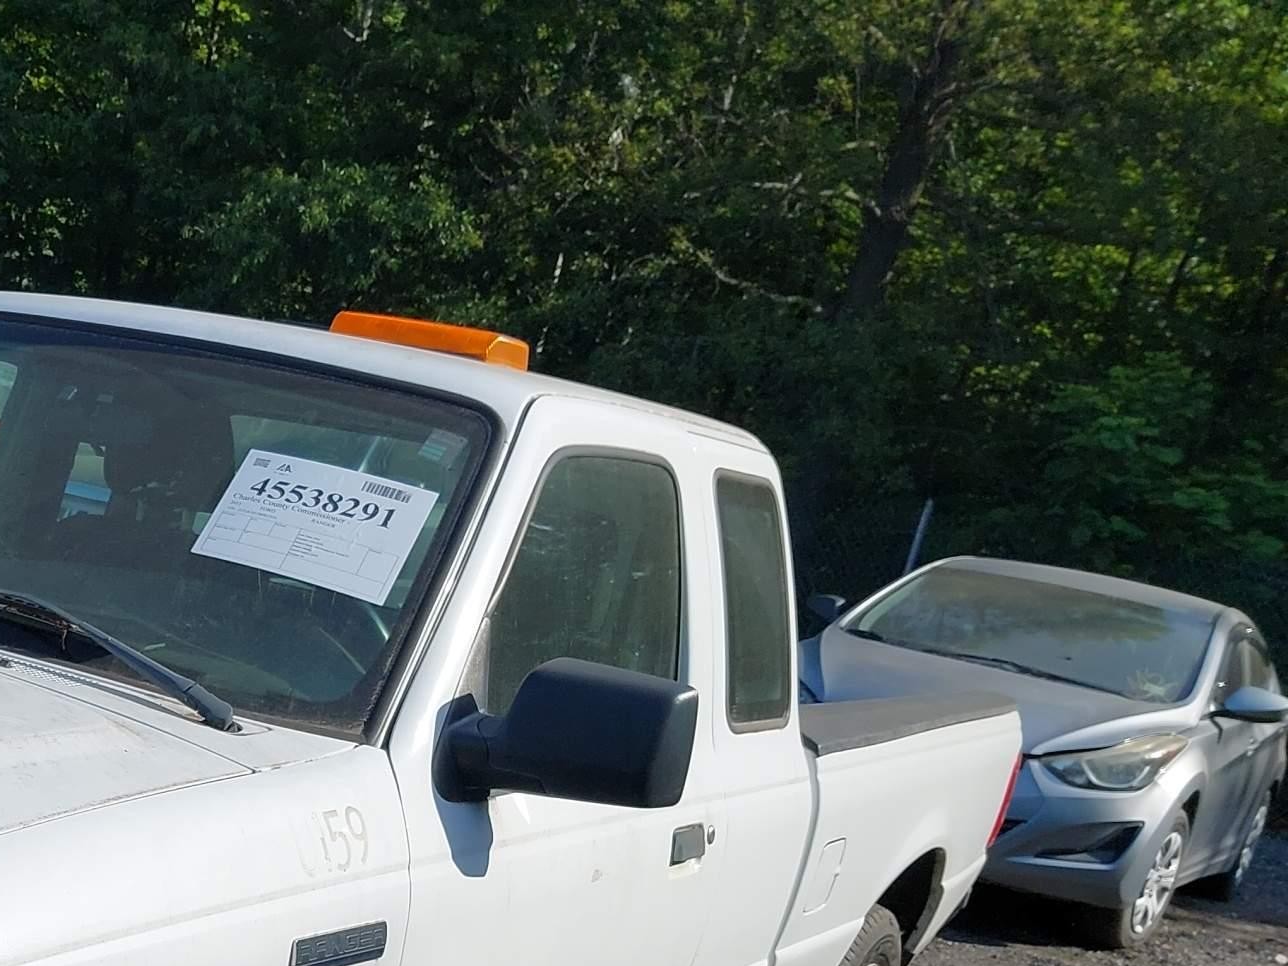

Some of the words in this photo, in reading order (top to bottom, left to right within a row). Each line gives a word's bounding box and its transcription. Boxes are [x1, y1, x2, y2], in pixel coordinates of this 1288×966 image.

[232, 491, 261, 505] Charles
[262, 497, 289, 511] County
[250, 478, 397, 530] 45538291
[296, 925, 384, 964] RANGER
